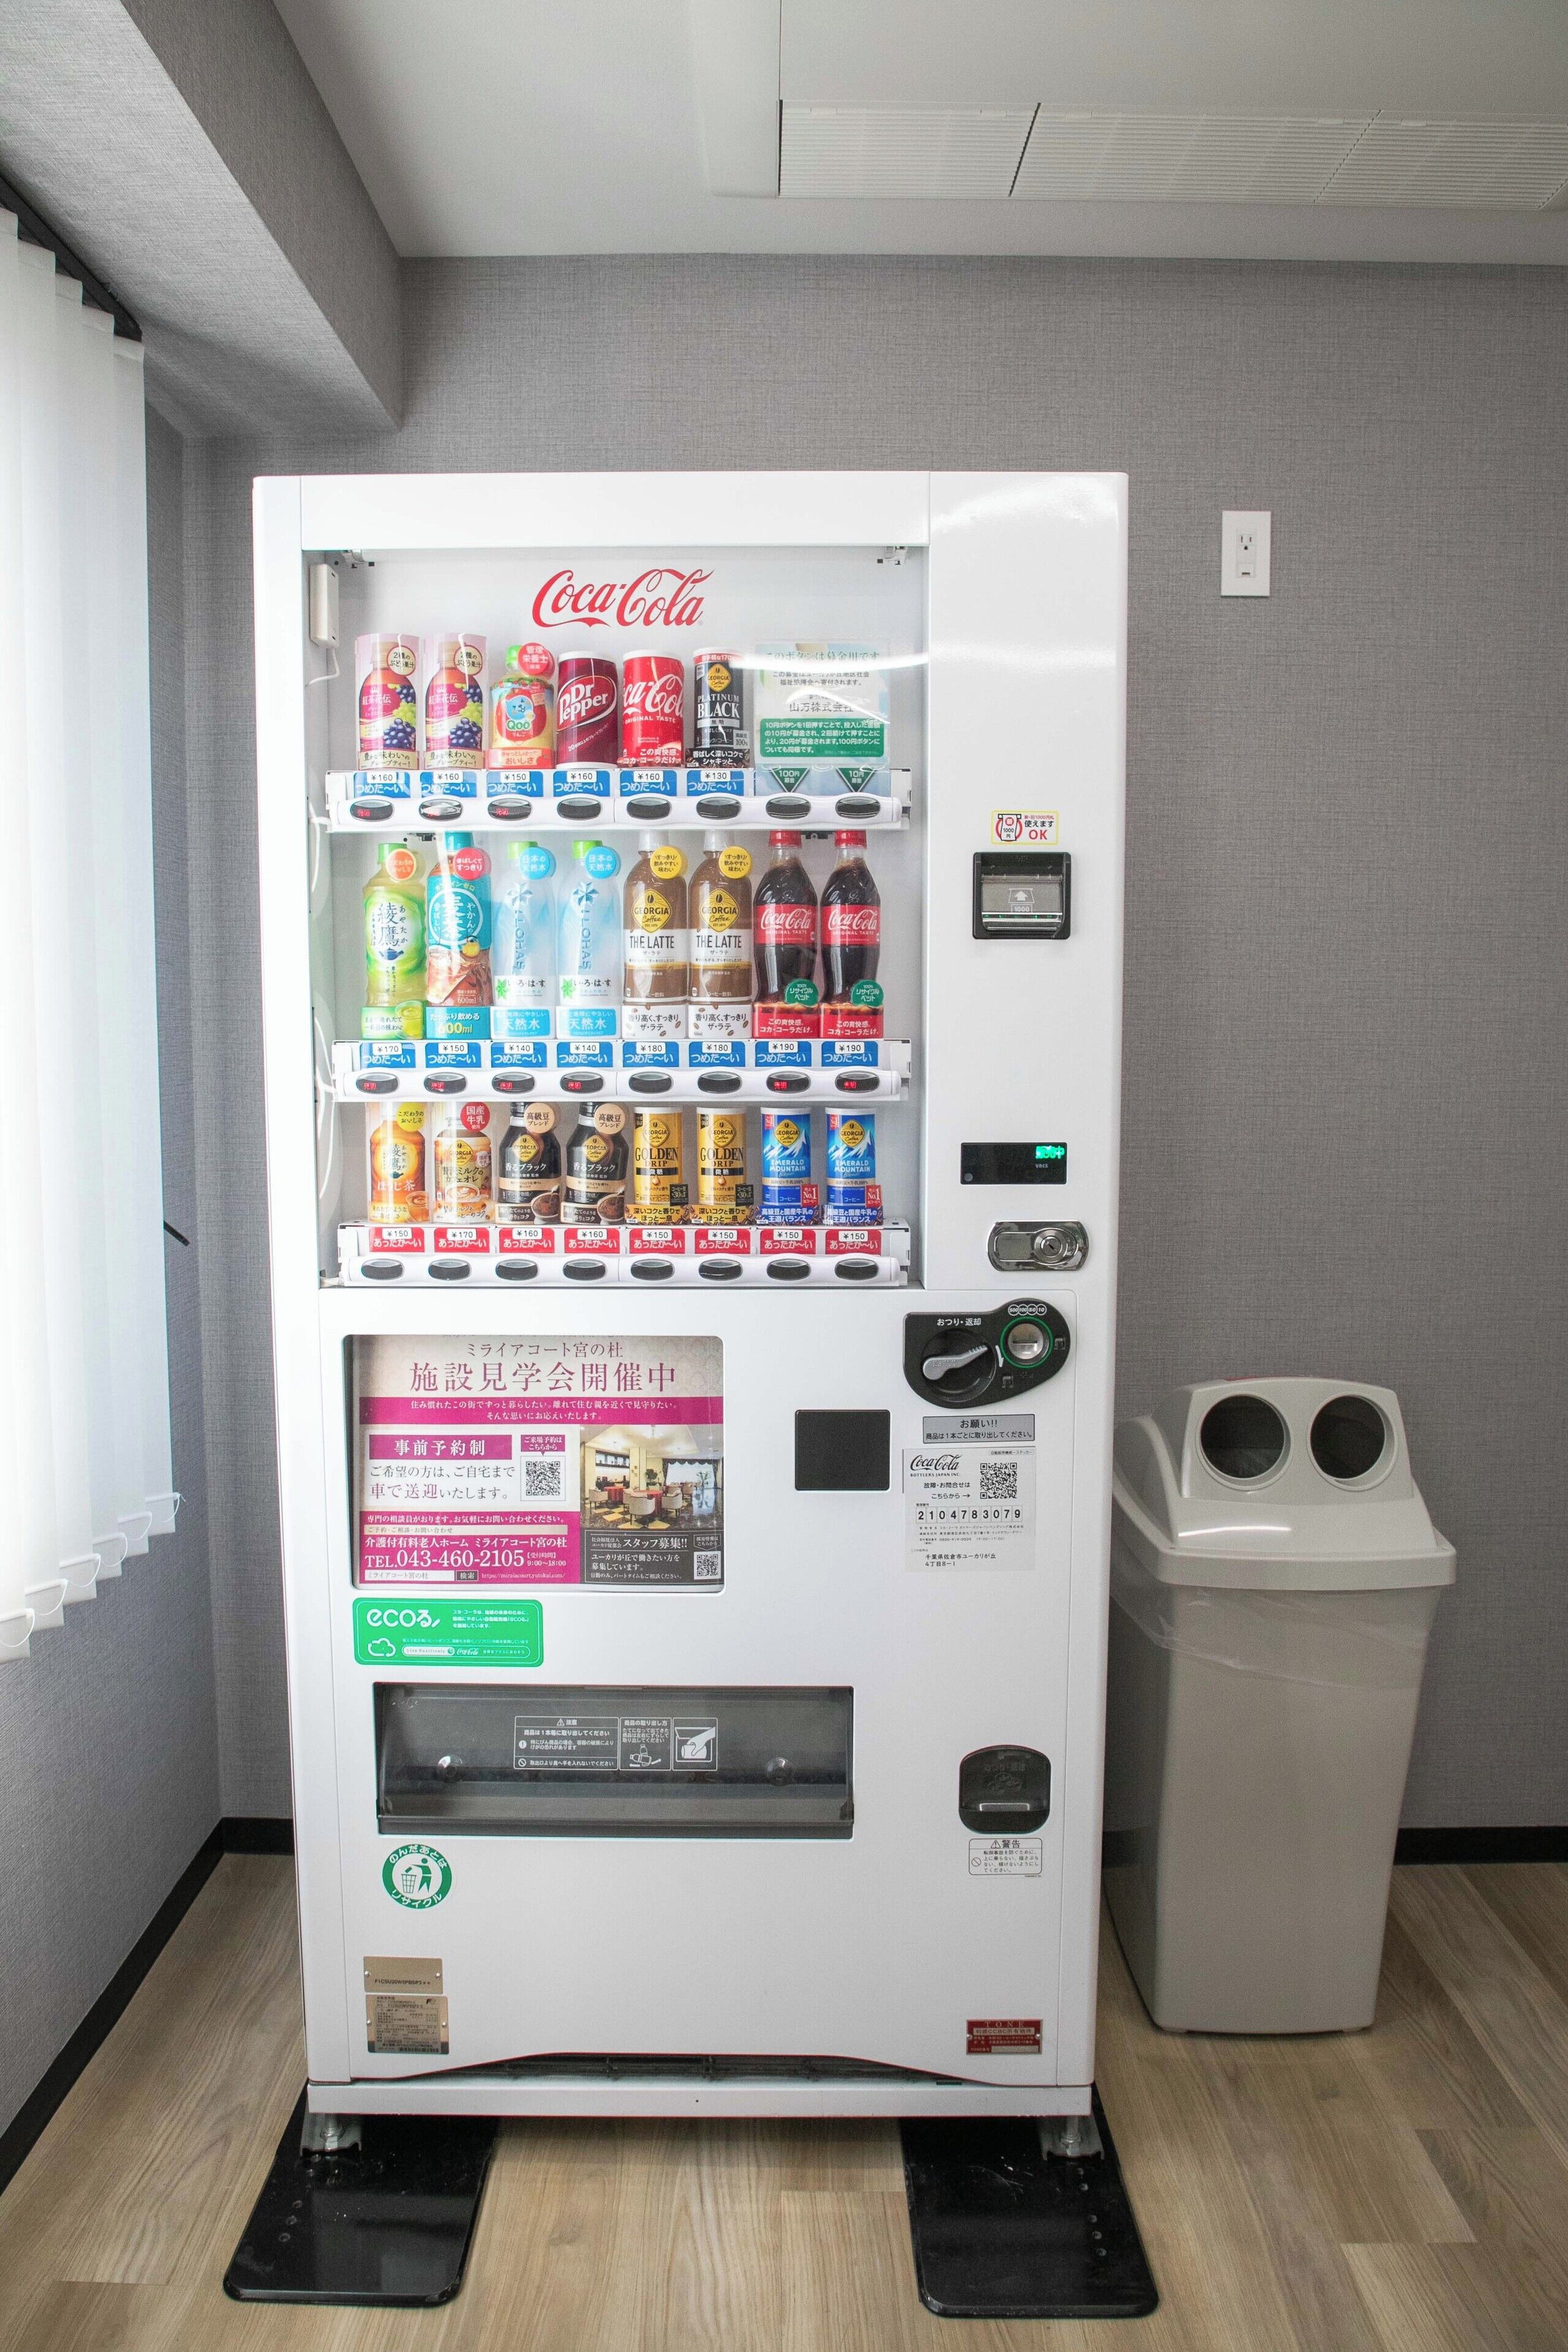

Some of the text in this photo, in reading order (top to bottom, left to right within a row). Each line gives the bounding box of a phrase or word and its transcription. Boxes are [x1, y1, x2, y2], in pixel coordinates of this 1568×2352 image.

[532, 568, 715, 628] Coca-Cola
[570, 684, 594, 702] Dr
[698, 694, 739, 704] PLATINUM
[559, 693, 608, 725] Pepper
[698, 702, 740, 718] BLACK
[625, 715, 653, 724] ORIGINAL
[507, 721, 530, 730] Qoo
[1028, 829, 1048, 840] OK
[635, 907, 669, 915] GEORGIA
[702, 907, 737, 915] GEORGIA
[761, 909, 812, 930] Coca-Cola
[828, 909, 877, 930] Coca-Cola
[630, 935, 674, 949] THE LATTE
[696, 935, 742, 949] THE LATTE
[575, 1044, 597, 1052] ¥140
[641, 1043, 662, 1052] ¥180
[707, 1043, 728, 1052] ¥180
[772, 1042, 794, 1051] ¥190
[839, 1044, 861, 1052] ¥190
[466, 1106, 485, 1115] 国産
[527, 1112, 550, 1120] 高級豆
[466, 1115, 485, 1125] 牛乳
[598, 1113, 621, 1121] 高級豆
[635, 1147, 679, 1161] GOLDEN
[700, 1147, 744, 1161] GOLDEN
[803, 1188, 817, 1199] No.1
[867, 1189, 881, 1200] No.1
[937, 1317, 981, 1327] おつり・返却
[467, 1341, 624, 1359] ミライアコート宮の杜
[409, 1362, 676, 1392] 施設見学会開催中
[960, 1419, 998, 1428] お願い!!
[925, 1431, 1032, 1440] 商品は1本ごとに取り出してください。
[393, 1439, 486, 1457] 事前予約制
[910, 1454, 963, 1471] Coca-Cola
[370, 1464, 516, 1479] ご希望の方は、ご自宅まで
[370, 1483, 508, 1500] 車で送迎いたします。
[364, 1536, 567, 1548] 介護付有料老人ホーム ミライアコート宮の杜
[622, 1537, 687, 1549] スタッフ募集!!
[591, 1553, 680, 1562] ユーカリが丘で働きたい方を
[389, 1844, 448, 1869] のんだあとは
[391, 1889, 442, 1909] リサイクル
